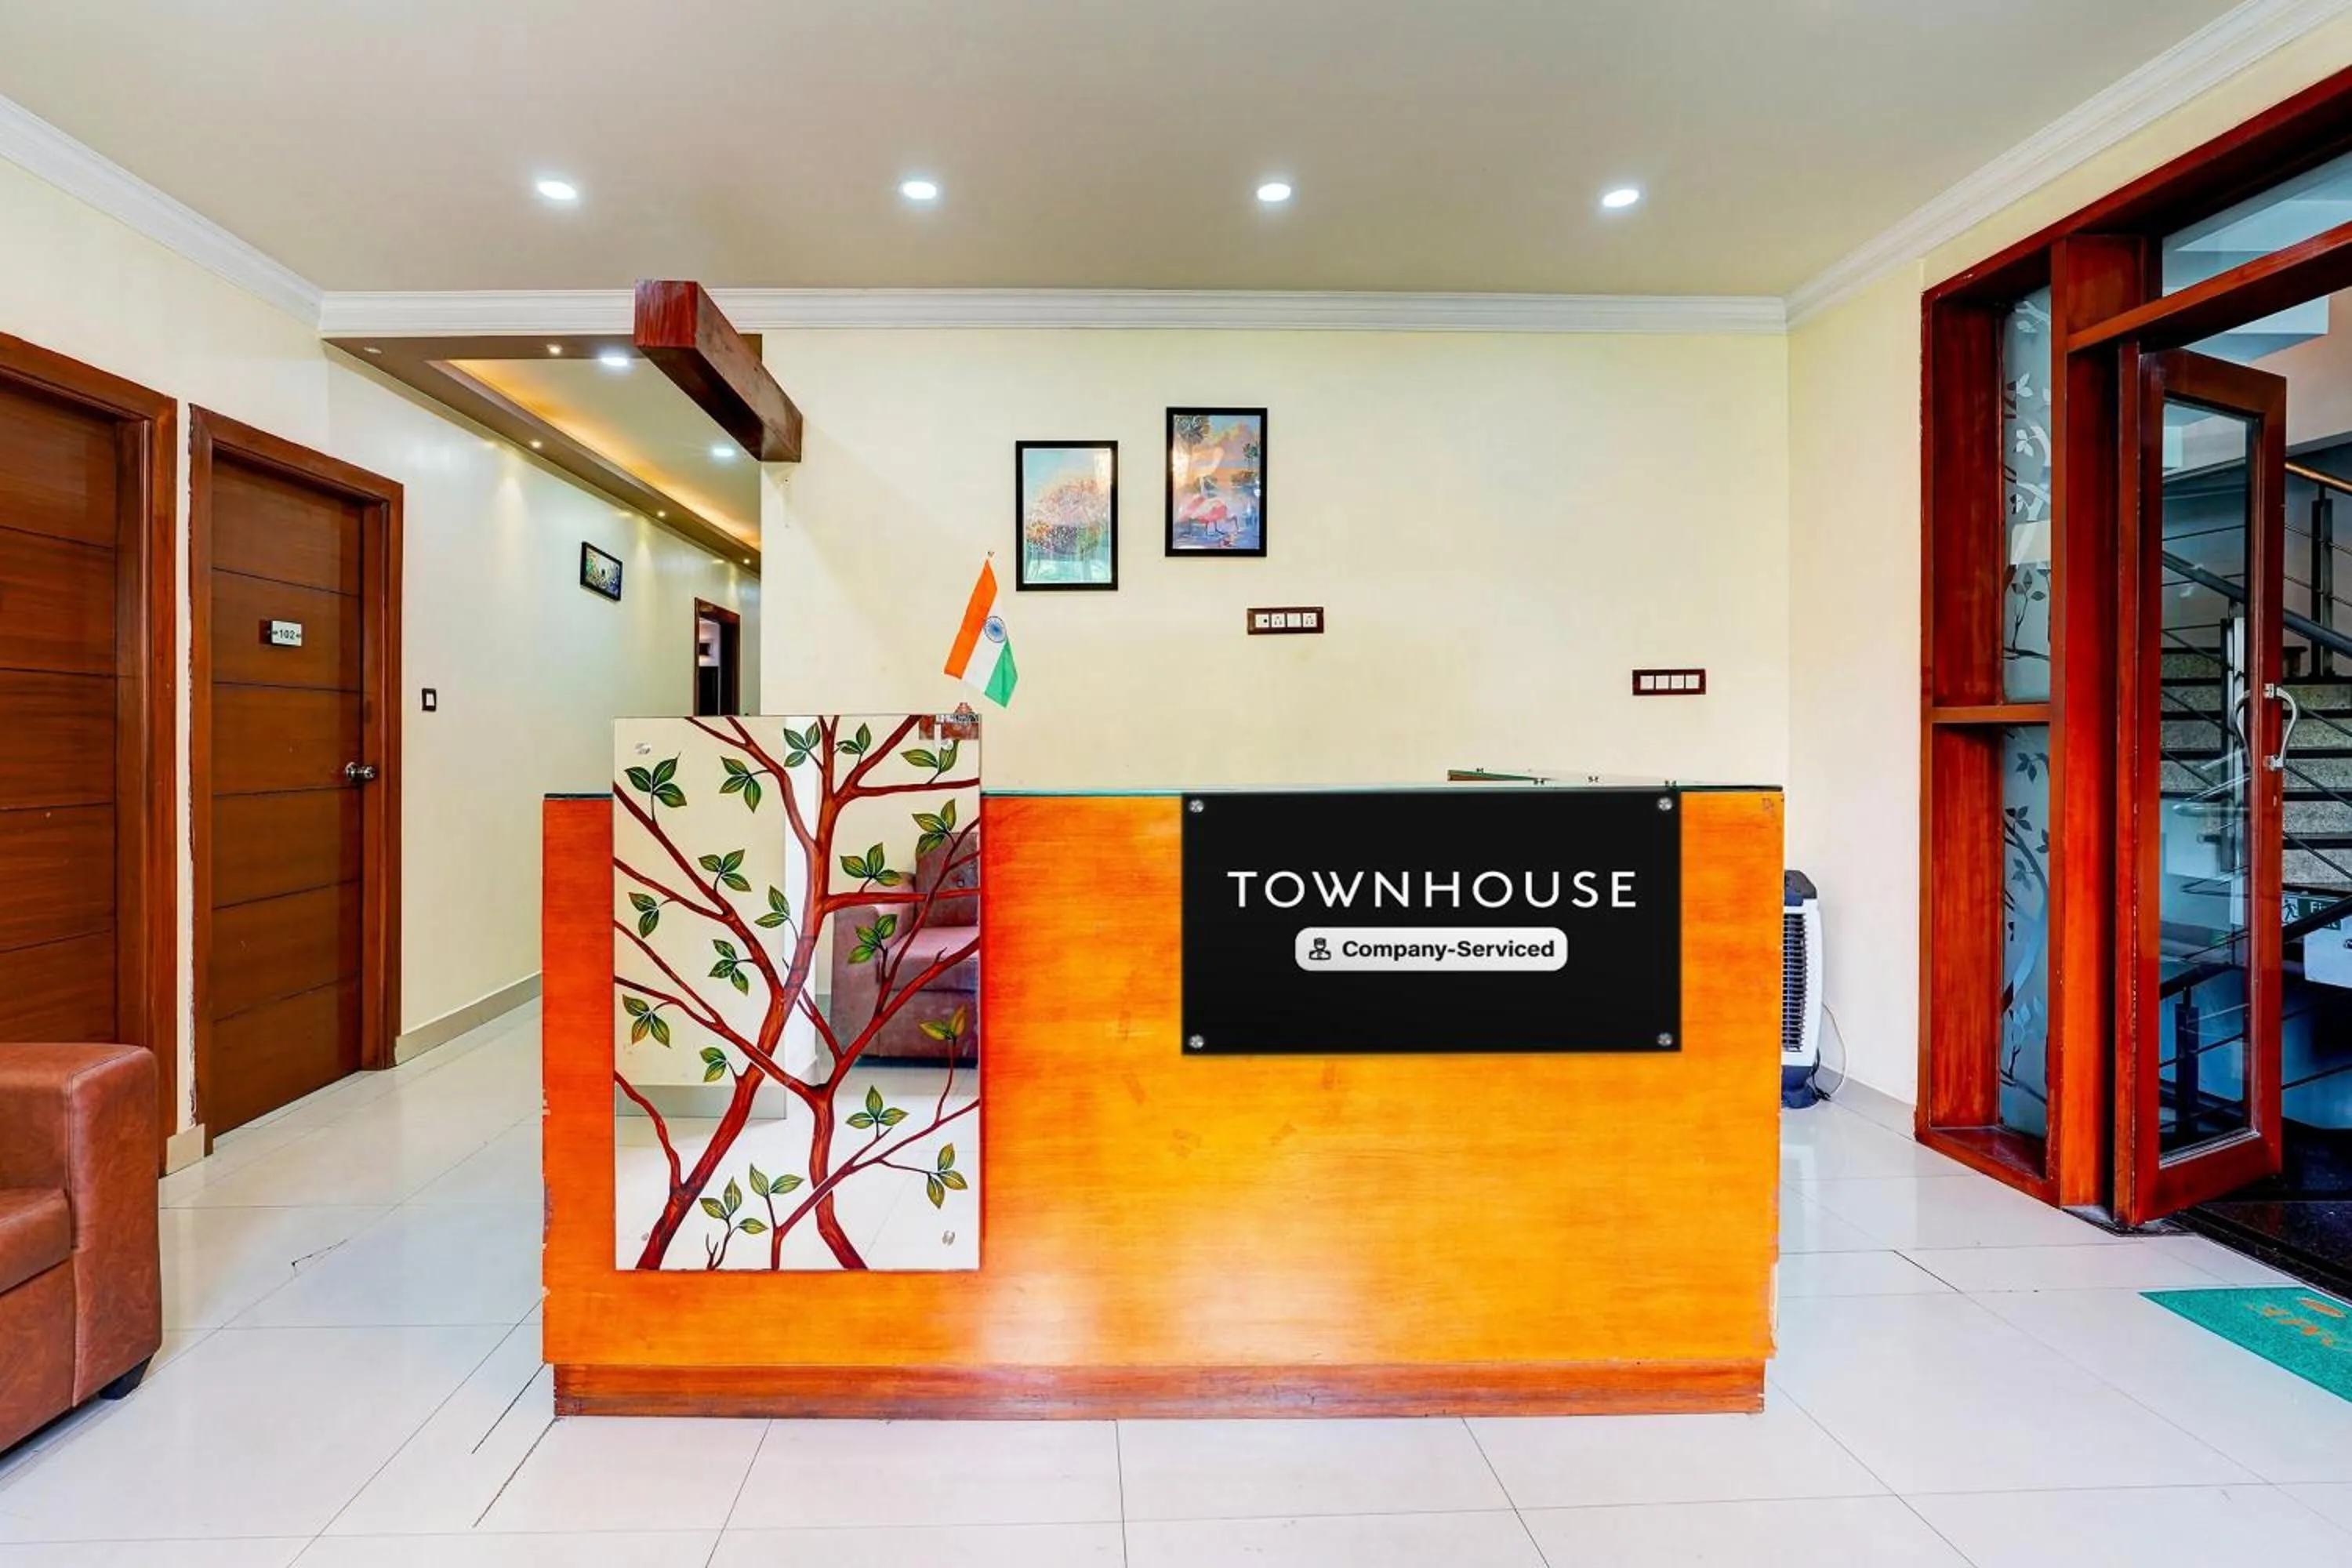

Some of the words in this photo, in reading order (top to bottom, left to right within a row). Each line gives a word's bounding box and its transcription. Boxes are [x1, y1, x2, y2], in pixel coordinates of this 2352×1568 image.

[279, 630, 296, 640] 102
[1227, 870, 1637, 909] TOWNHOUSE
[1342, 940, 1555, 962] Company-Serviced
